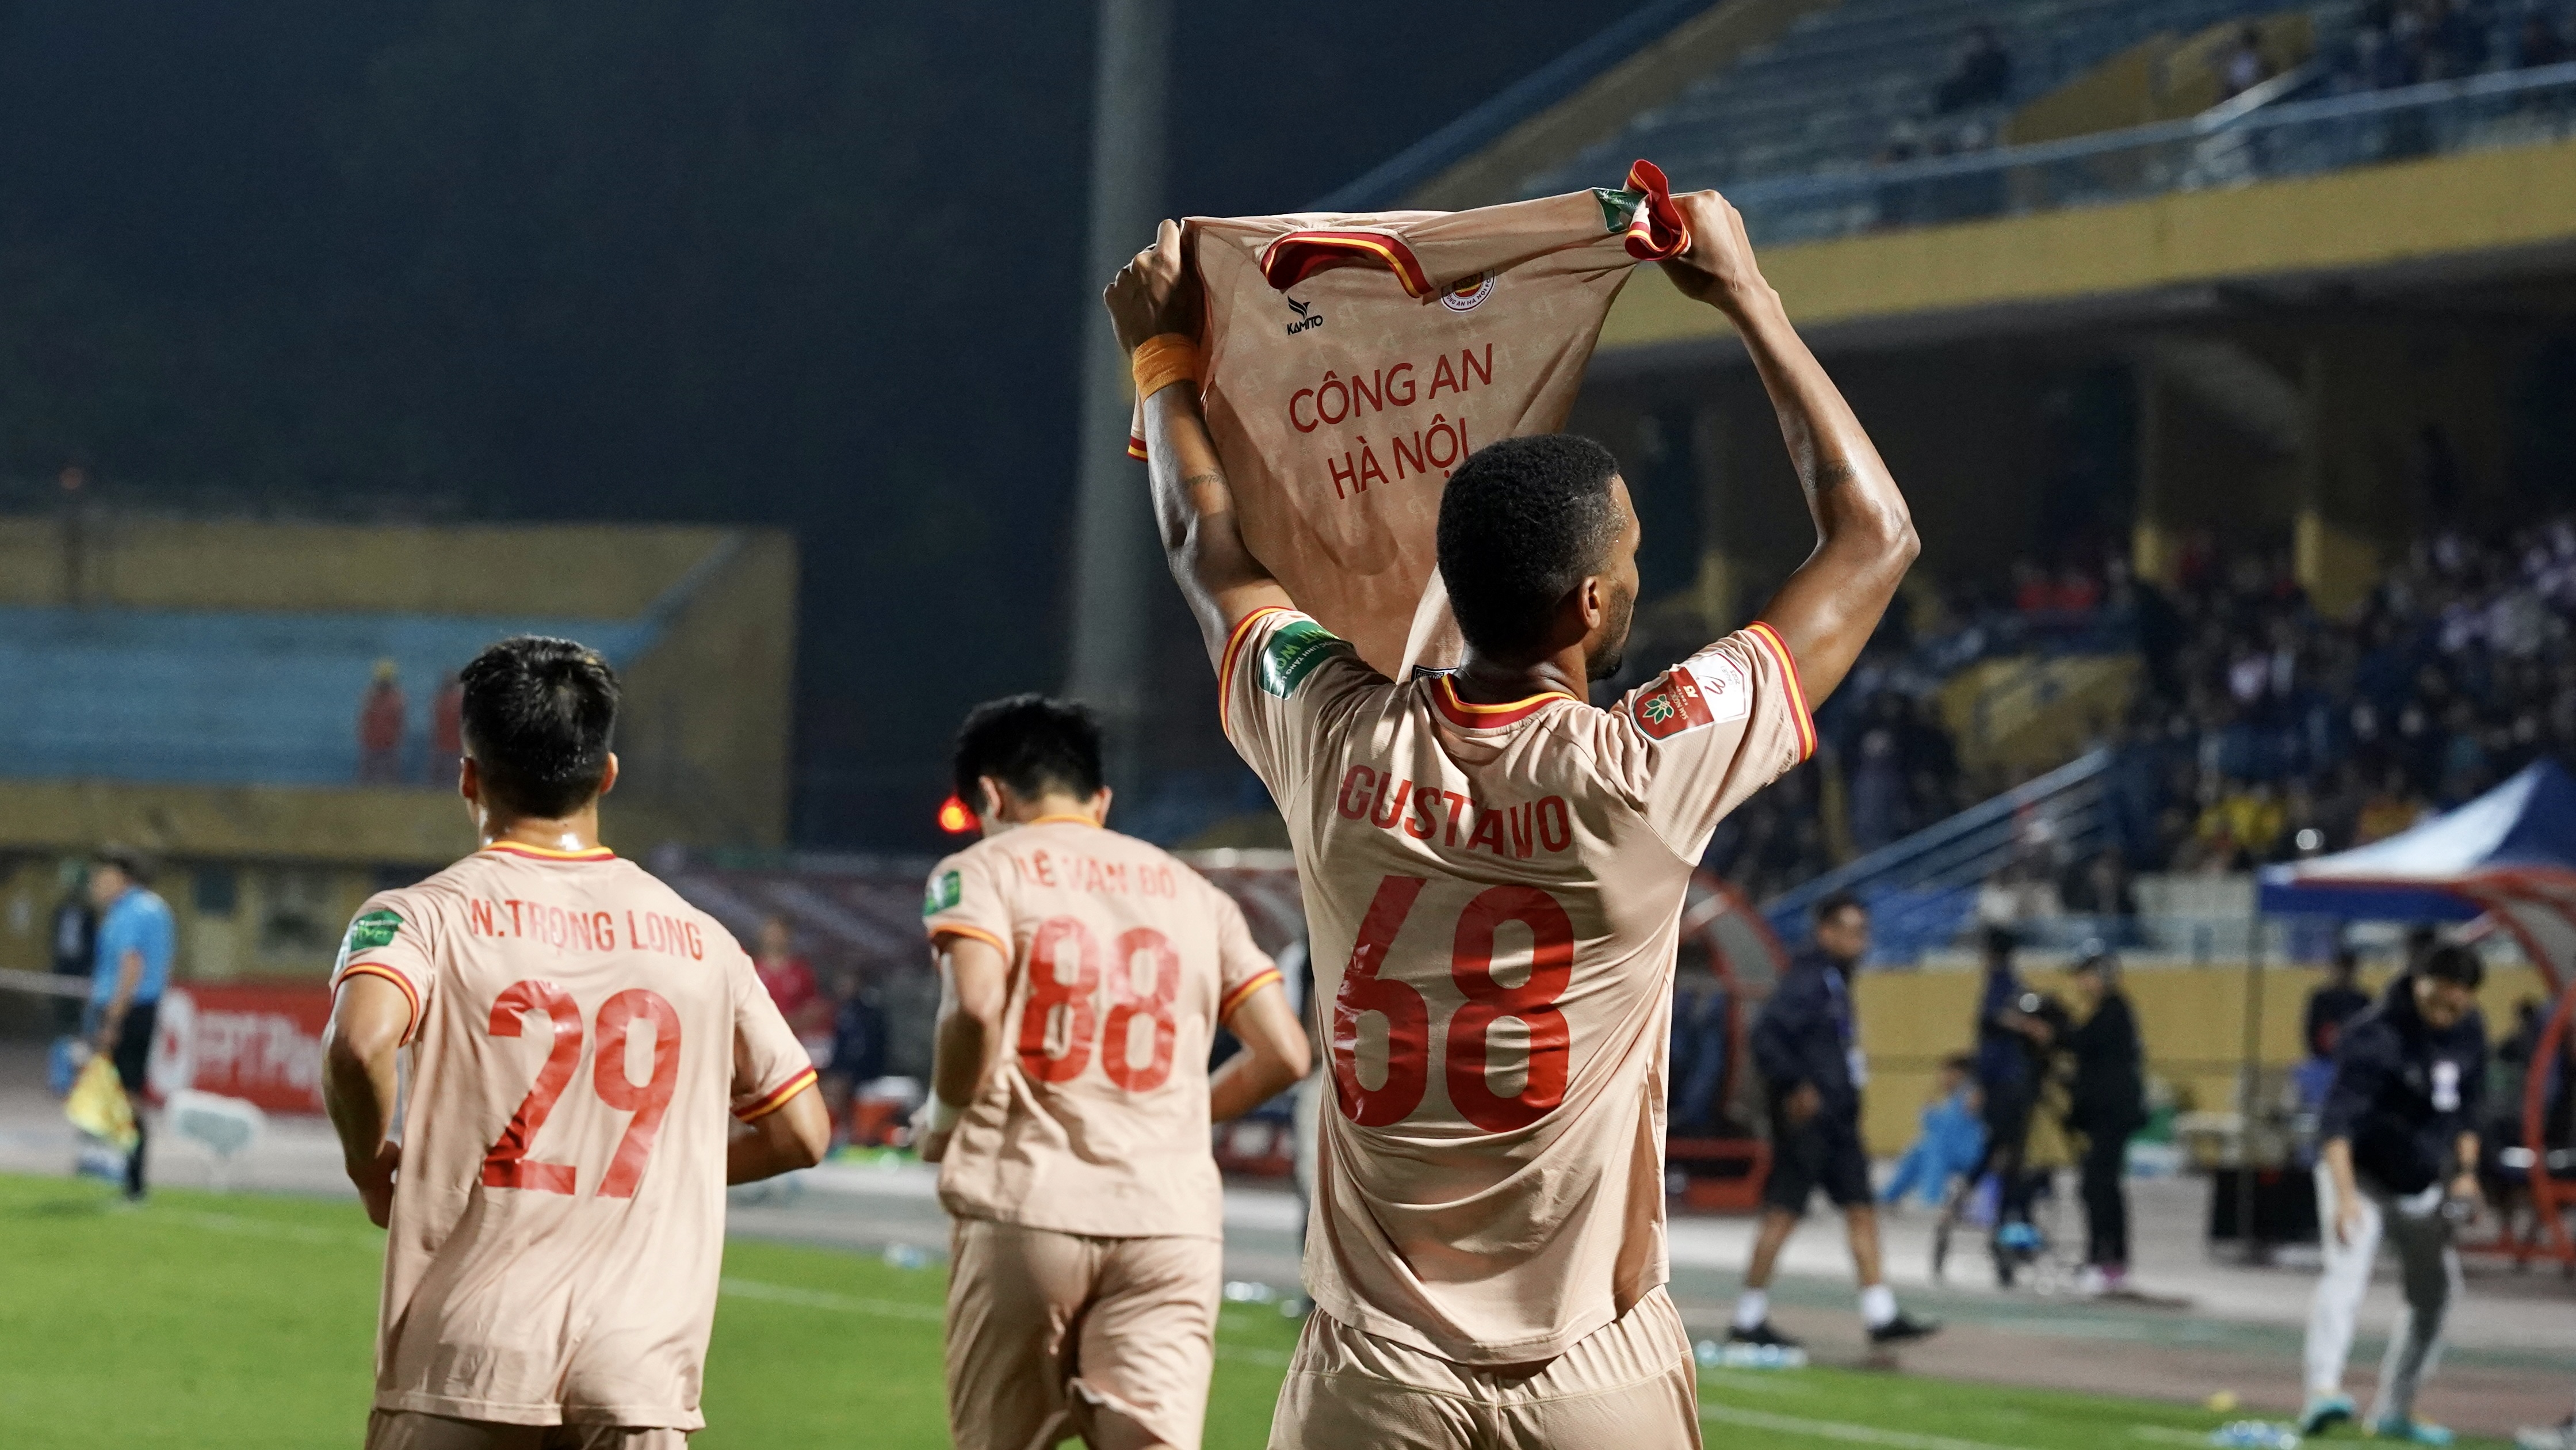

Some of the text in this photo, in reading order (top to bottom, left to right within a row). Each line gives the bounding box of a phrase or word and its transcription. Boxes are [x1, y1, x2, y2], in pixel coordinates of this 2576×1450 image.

[1287, 315, 1323, 335] KAMITO
[1289, 343, 1492, 433] CÔNG AN
[1328, 413, 1470, 499] HÀ NỘI
[1338, 765, 1572, 858] GUSTAVO
[626, 909, 704, 961] LONG
[1018, 914, 1181, 1092] 88
[1333, 874, 1574, 1133] 68
[482, 979, 682, 1199] 29
